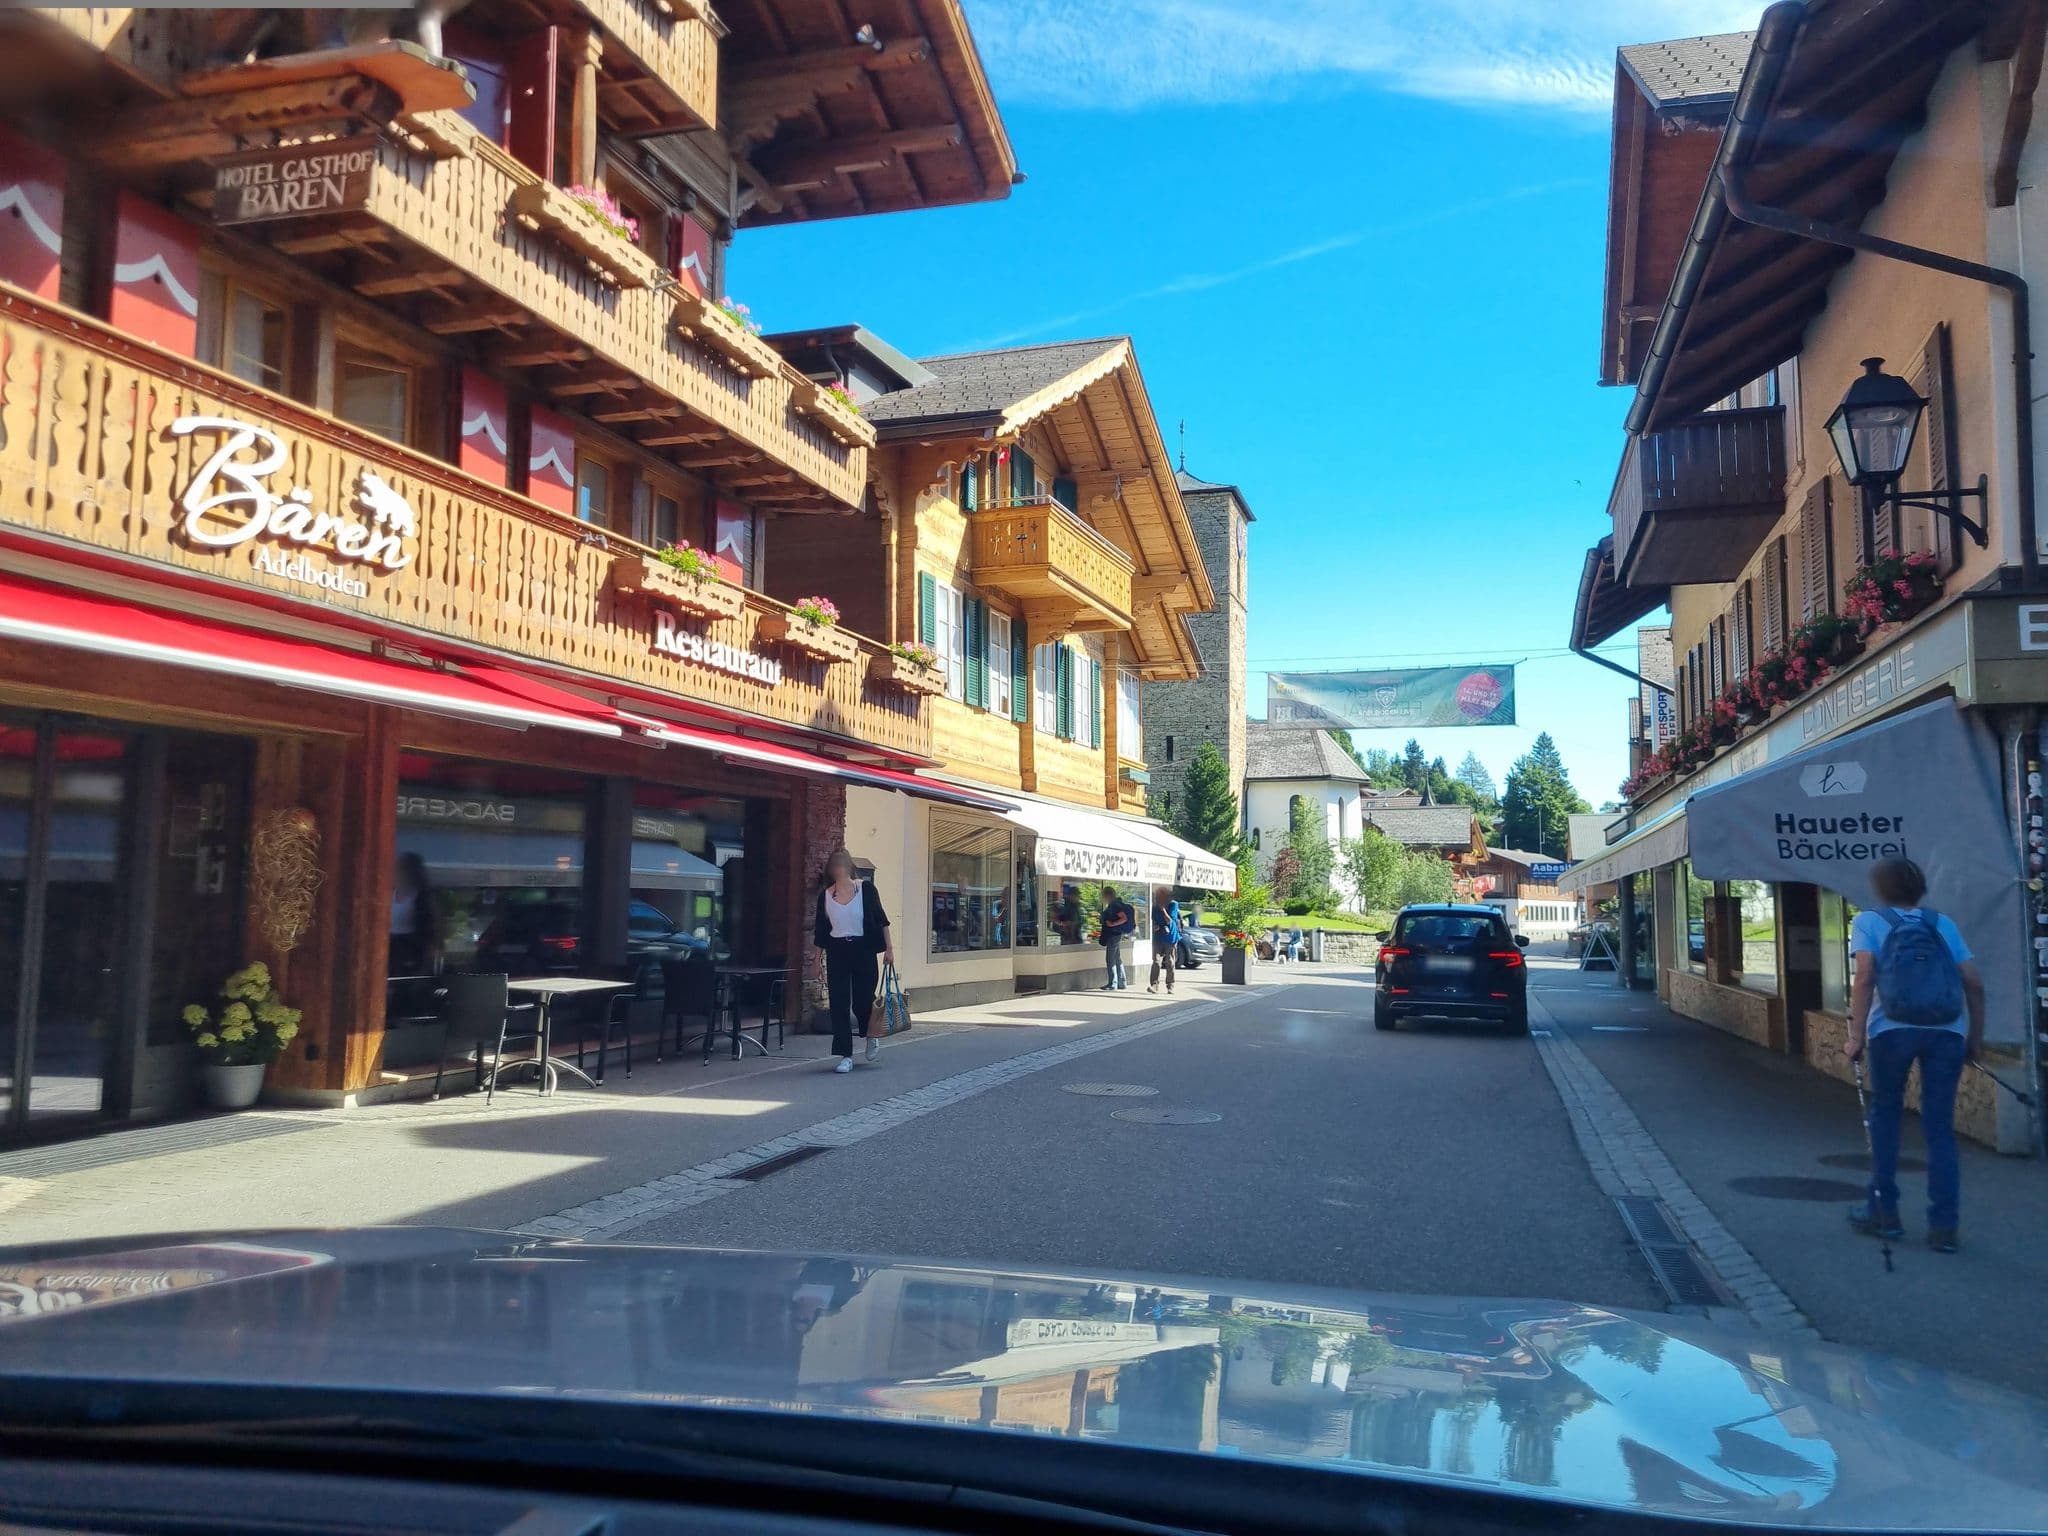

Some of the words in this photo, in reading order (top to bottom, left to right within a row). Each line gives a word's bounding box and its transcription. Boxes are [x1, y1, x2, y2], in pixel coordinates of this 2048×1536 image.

[216, 162, 279, 189] HOTEL
[282, 151, 374, 181] GASTHOF
[239, 175, 347, 217] BÄREN
[172, 416, 412, 569] Bären
[252, 547, 368, 599] Adelboden
[654, 610, 783, 685] Restaurant
[1802, 643, 1915, 739] CONFISERIE
[1775, 812, 1903, 834] Haueter
[1064, 848, 1094, 874] CRAZY
[1095, 854, 1125, 876] SPORTS
[1777, 838, 1907, 860] Bäckerei
